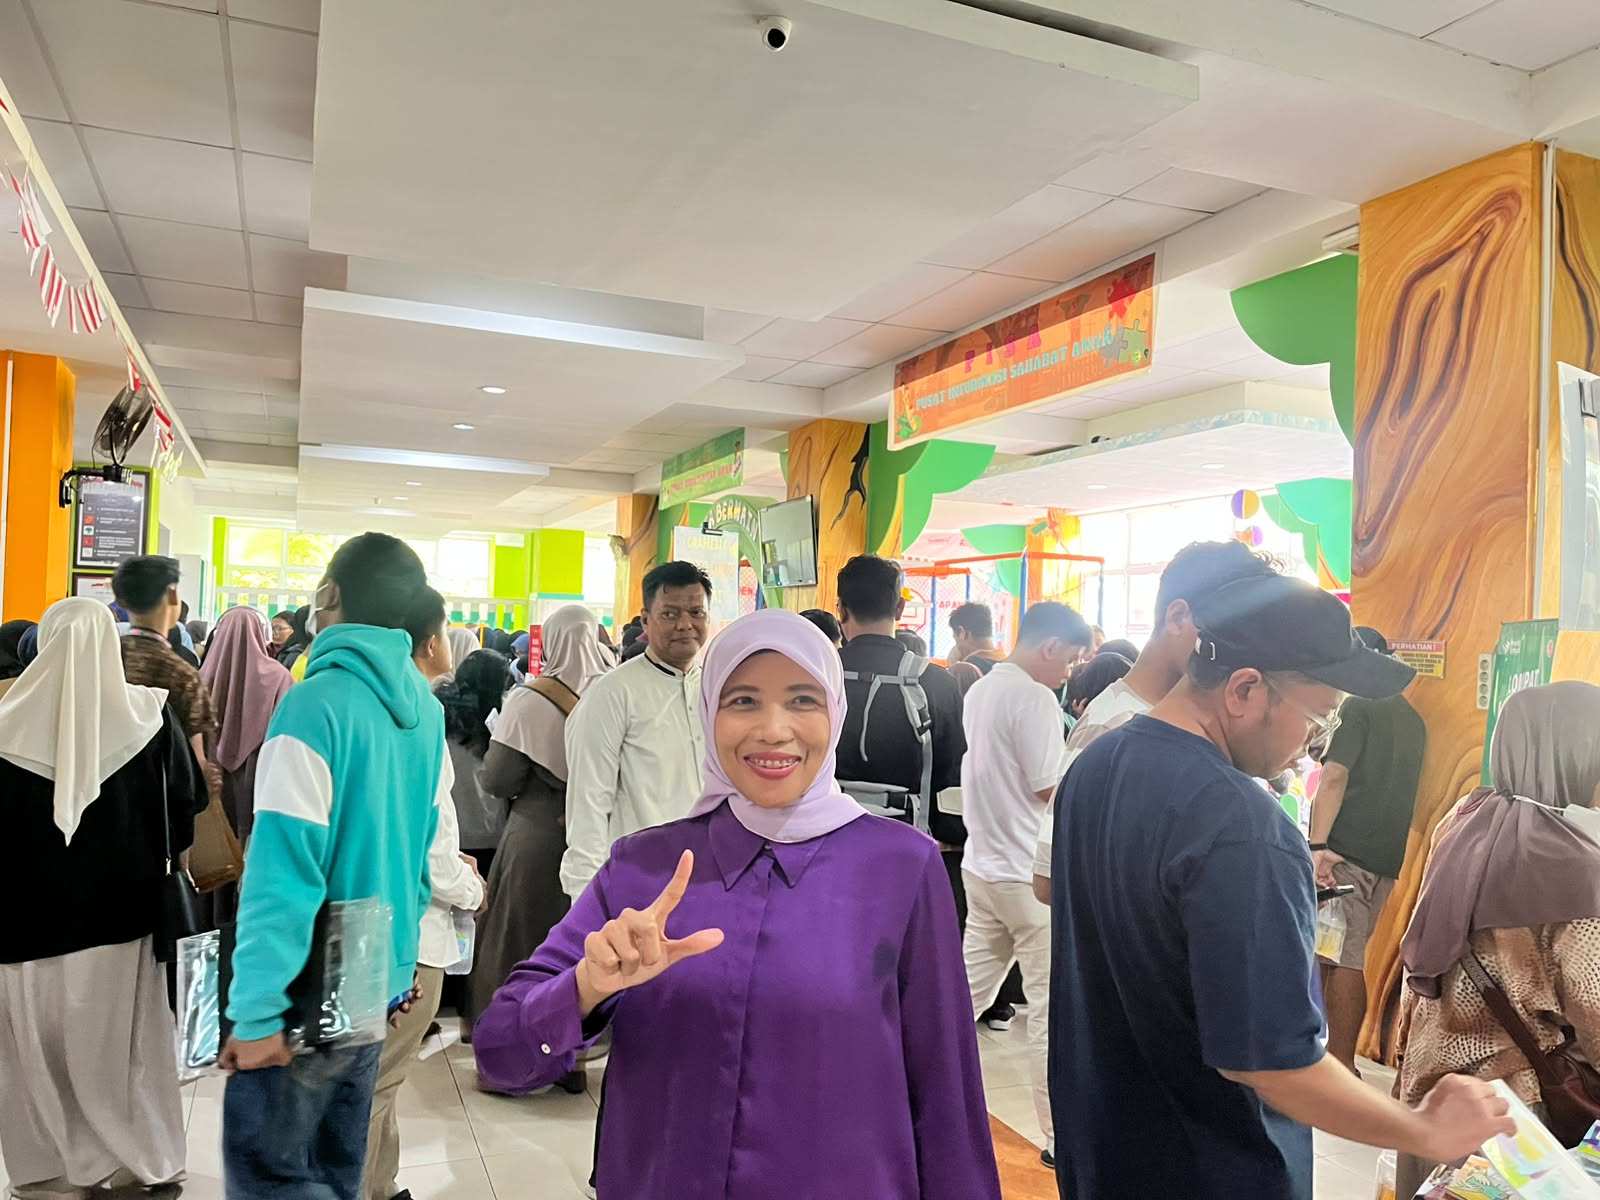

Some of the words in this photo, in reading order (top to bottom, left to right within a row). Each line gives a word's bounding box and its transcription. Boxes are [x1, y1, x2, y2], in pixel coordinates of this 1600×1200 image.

[915, 390, 944, 411] PUSAT
[948, 368, 1008, 400] INFORMASI
[1009, 345, 1068, 378] SAHABAT
